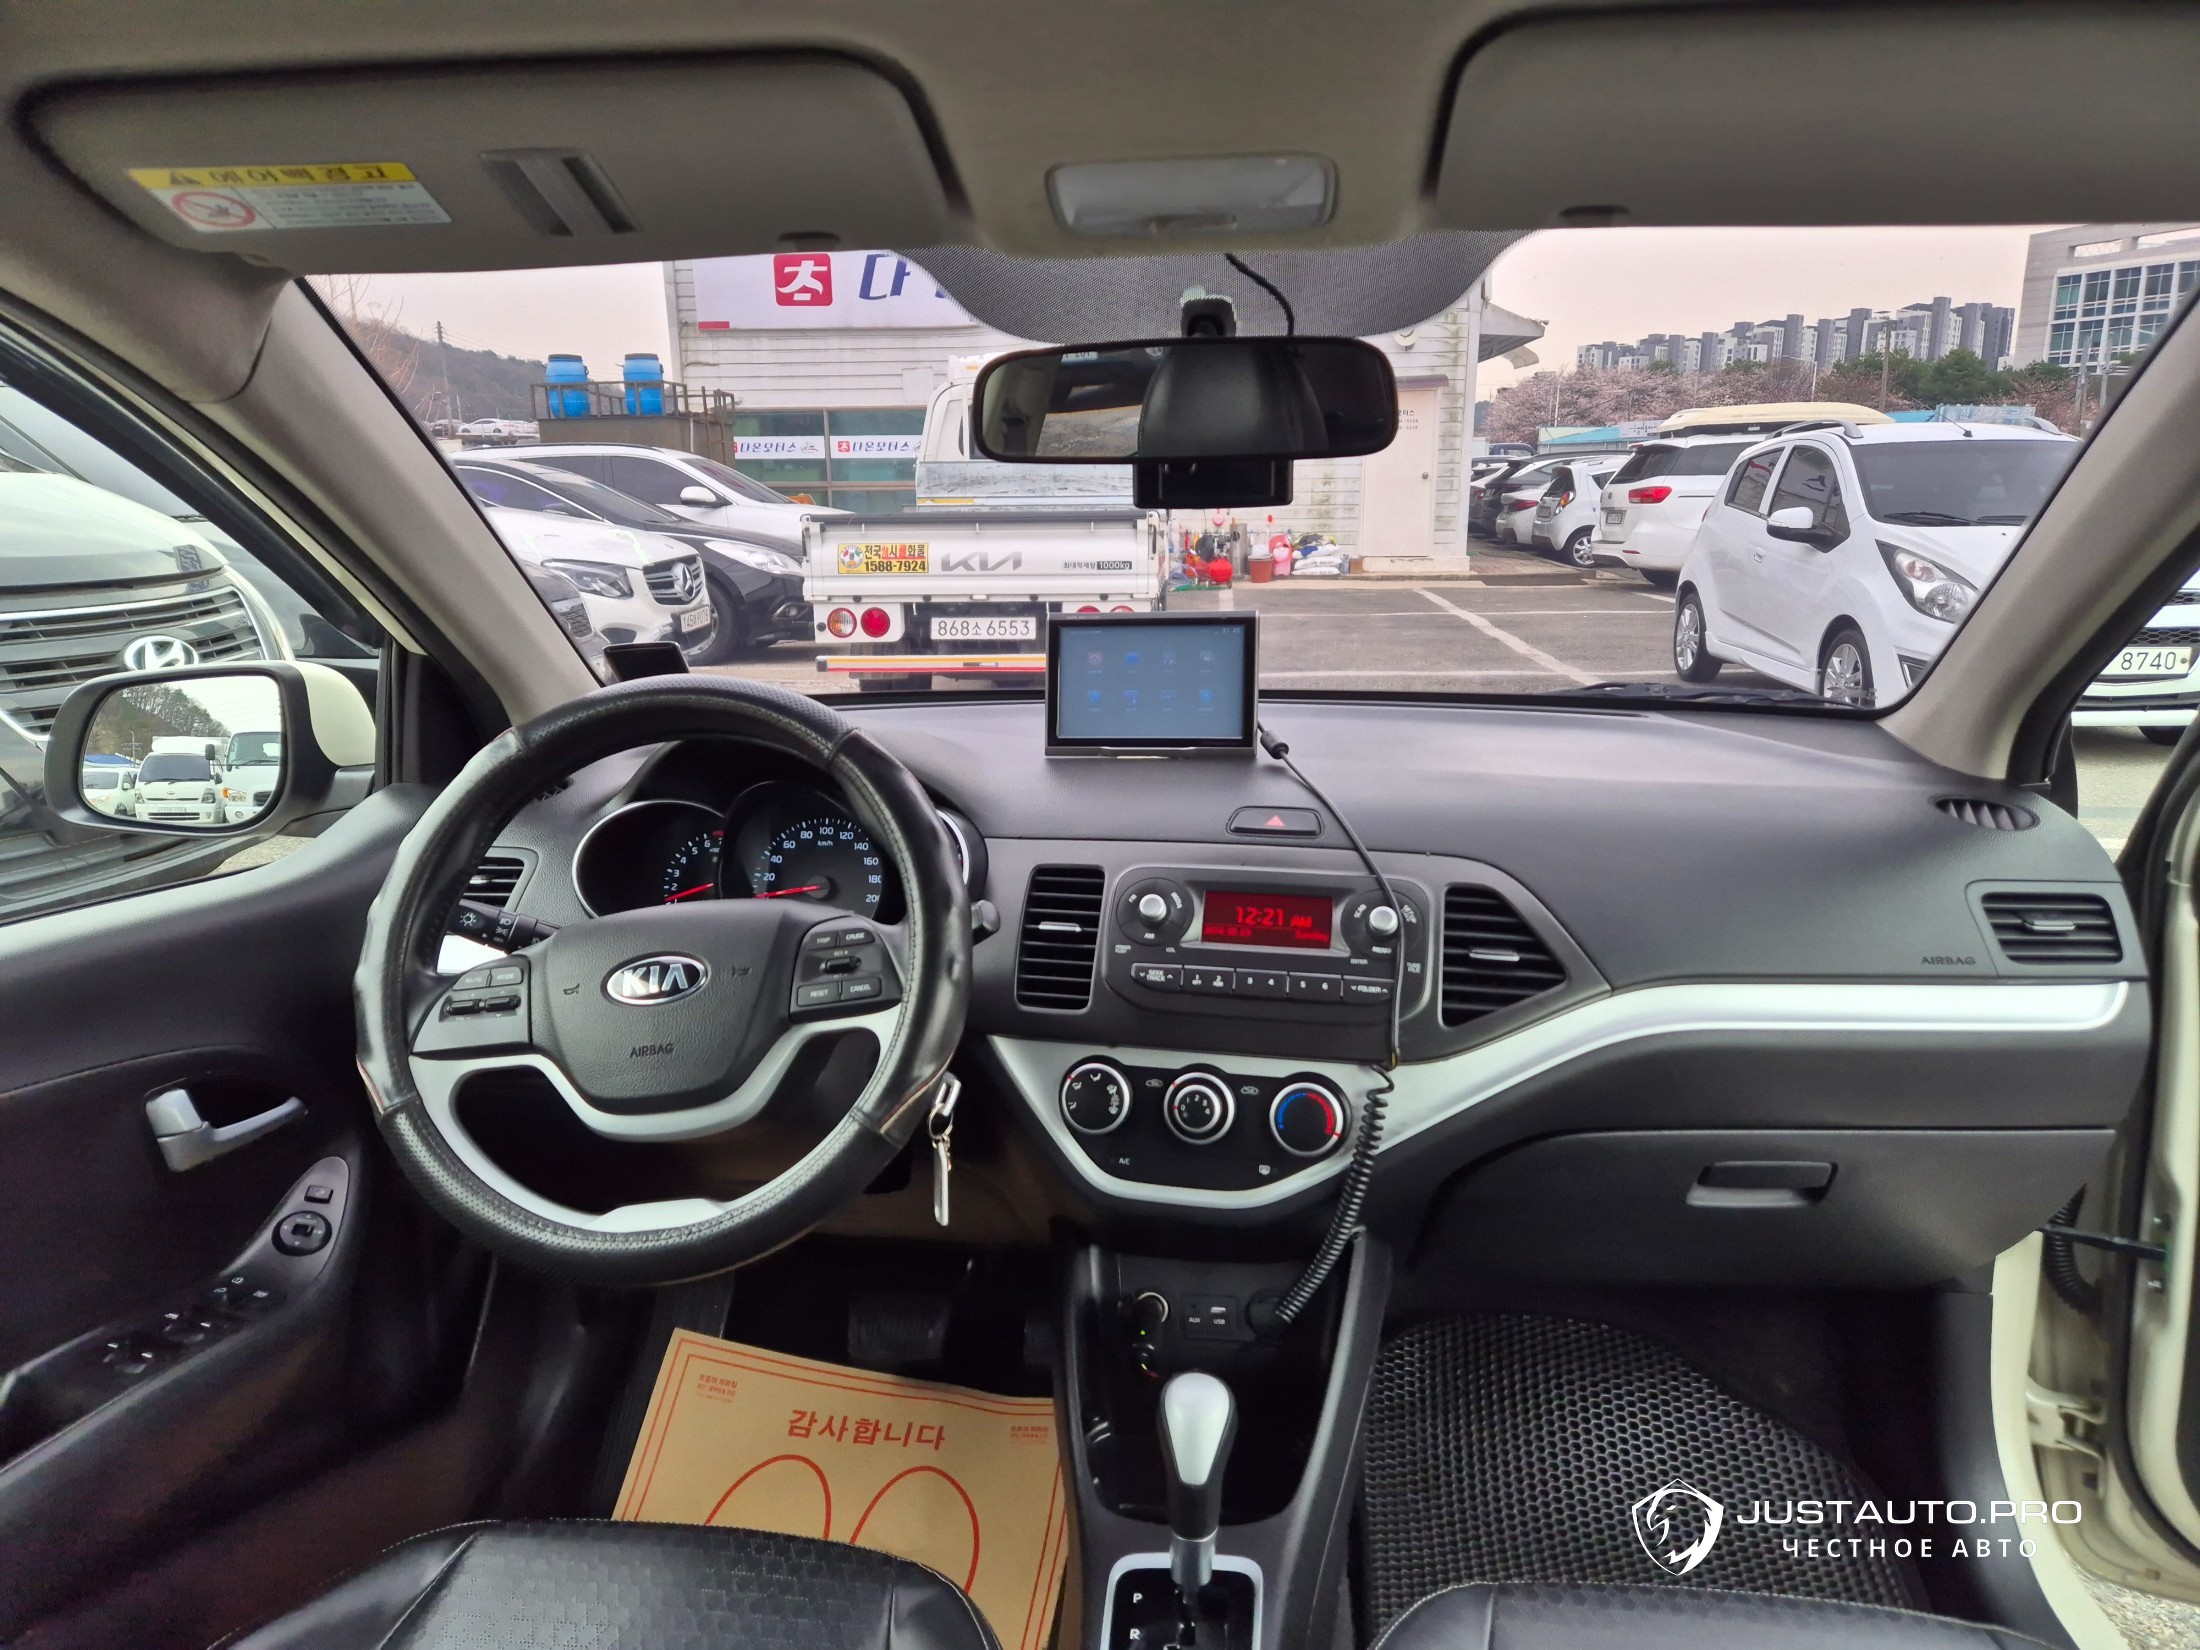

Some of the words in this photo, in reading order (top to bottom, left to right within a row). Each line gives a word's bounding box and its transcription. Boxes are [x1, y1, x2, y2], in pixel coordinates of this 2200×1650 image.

[740, 441, 797, 453] 다온모터스
[852, 441, 909, 453] 다온모터스
[864, 560, 926, 572] 1588-7924
[1099, 561, 1130, 570] 1000kg
[938, 618, 982, 637] 868소
[986, 618, 1030, 637] 6553
[2121, 651, 2177, 671] 8740
[819, 826, 834, 835] 100
[800, 831, 813, 840] 80
[839, 831, 854, 840] 120
[704, 840, 711, 848] 6
[783, 840, 796, 849] 60
[817, 839, 833, 847] km/h
[854, 842, 869, 851] 140
[692, 847, 698, 855] 5
[770, 855, 783, 864] 40
[863, 857, 879, 866] 160
[673, 869, 680, 877] 3
[763, 873, 776, 881] 20
[671, 883, 678, 891] 2
[1235, 905, 1285, 927] 12:21
[1920, 955, 1976, 966] AIRBAG
[621, 962, 690, 998] KIA
[629, 1042, 675, 1058] AIRBAG
[1194, 1093, 1200, 1102] 2
[787, 1409, 946, 1451] 감사합니다
[1132, 1592, 1144, 1604] P
[1128, 1628, 1141, 1641] R
